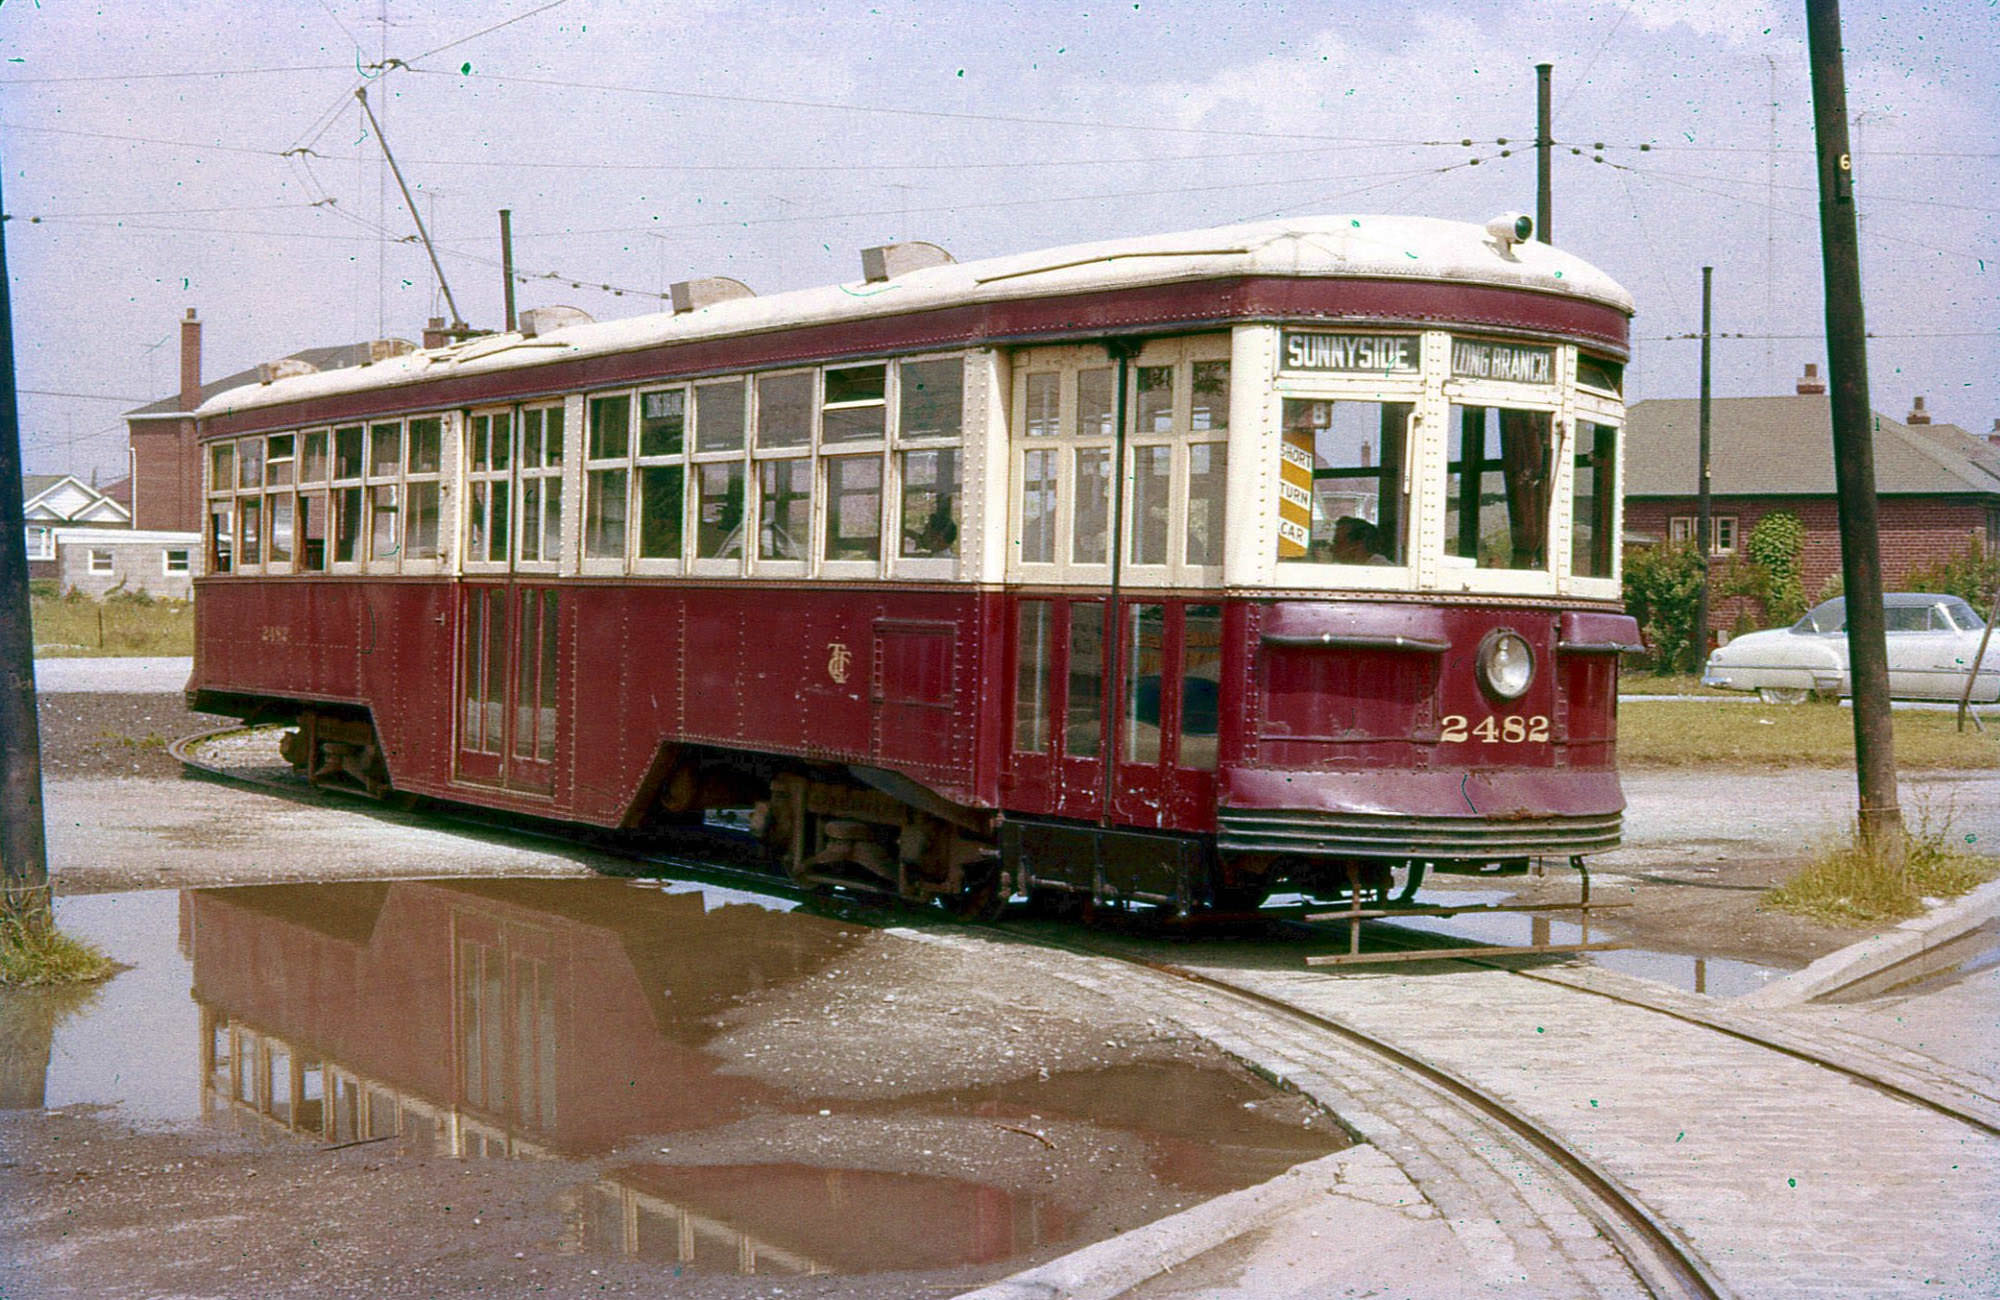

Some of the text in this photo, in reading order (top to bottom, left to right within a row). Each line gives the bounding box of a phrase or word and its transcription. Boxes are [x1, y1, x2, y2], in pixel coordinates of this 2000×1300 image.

[1840, 154, 1851, 170] 6
[1288, 335, 1409, 369] SUNNYSIDE
[1453, 342, 1550, 383] LONG BRANCH
[1280, 443, 1312, 469] SHORT
[1280, 481, 1308, 505] TURN
[1280, 521, 1304, 542] CAR
[1440, 715, 1549, 743] 2482
